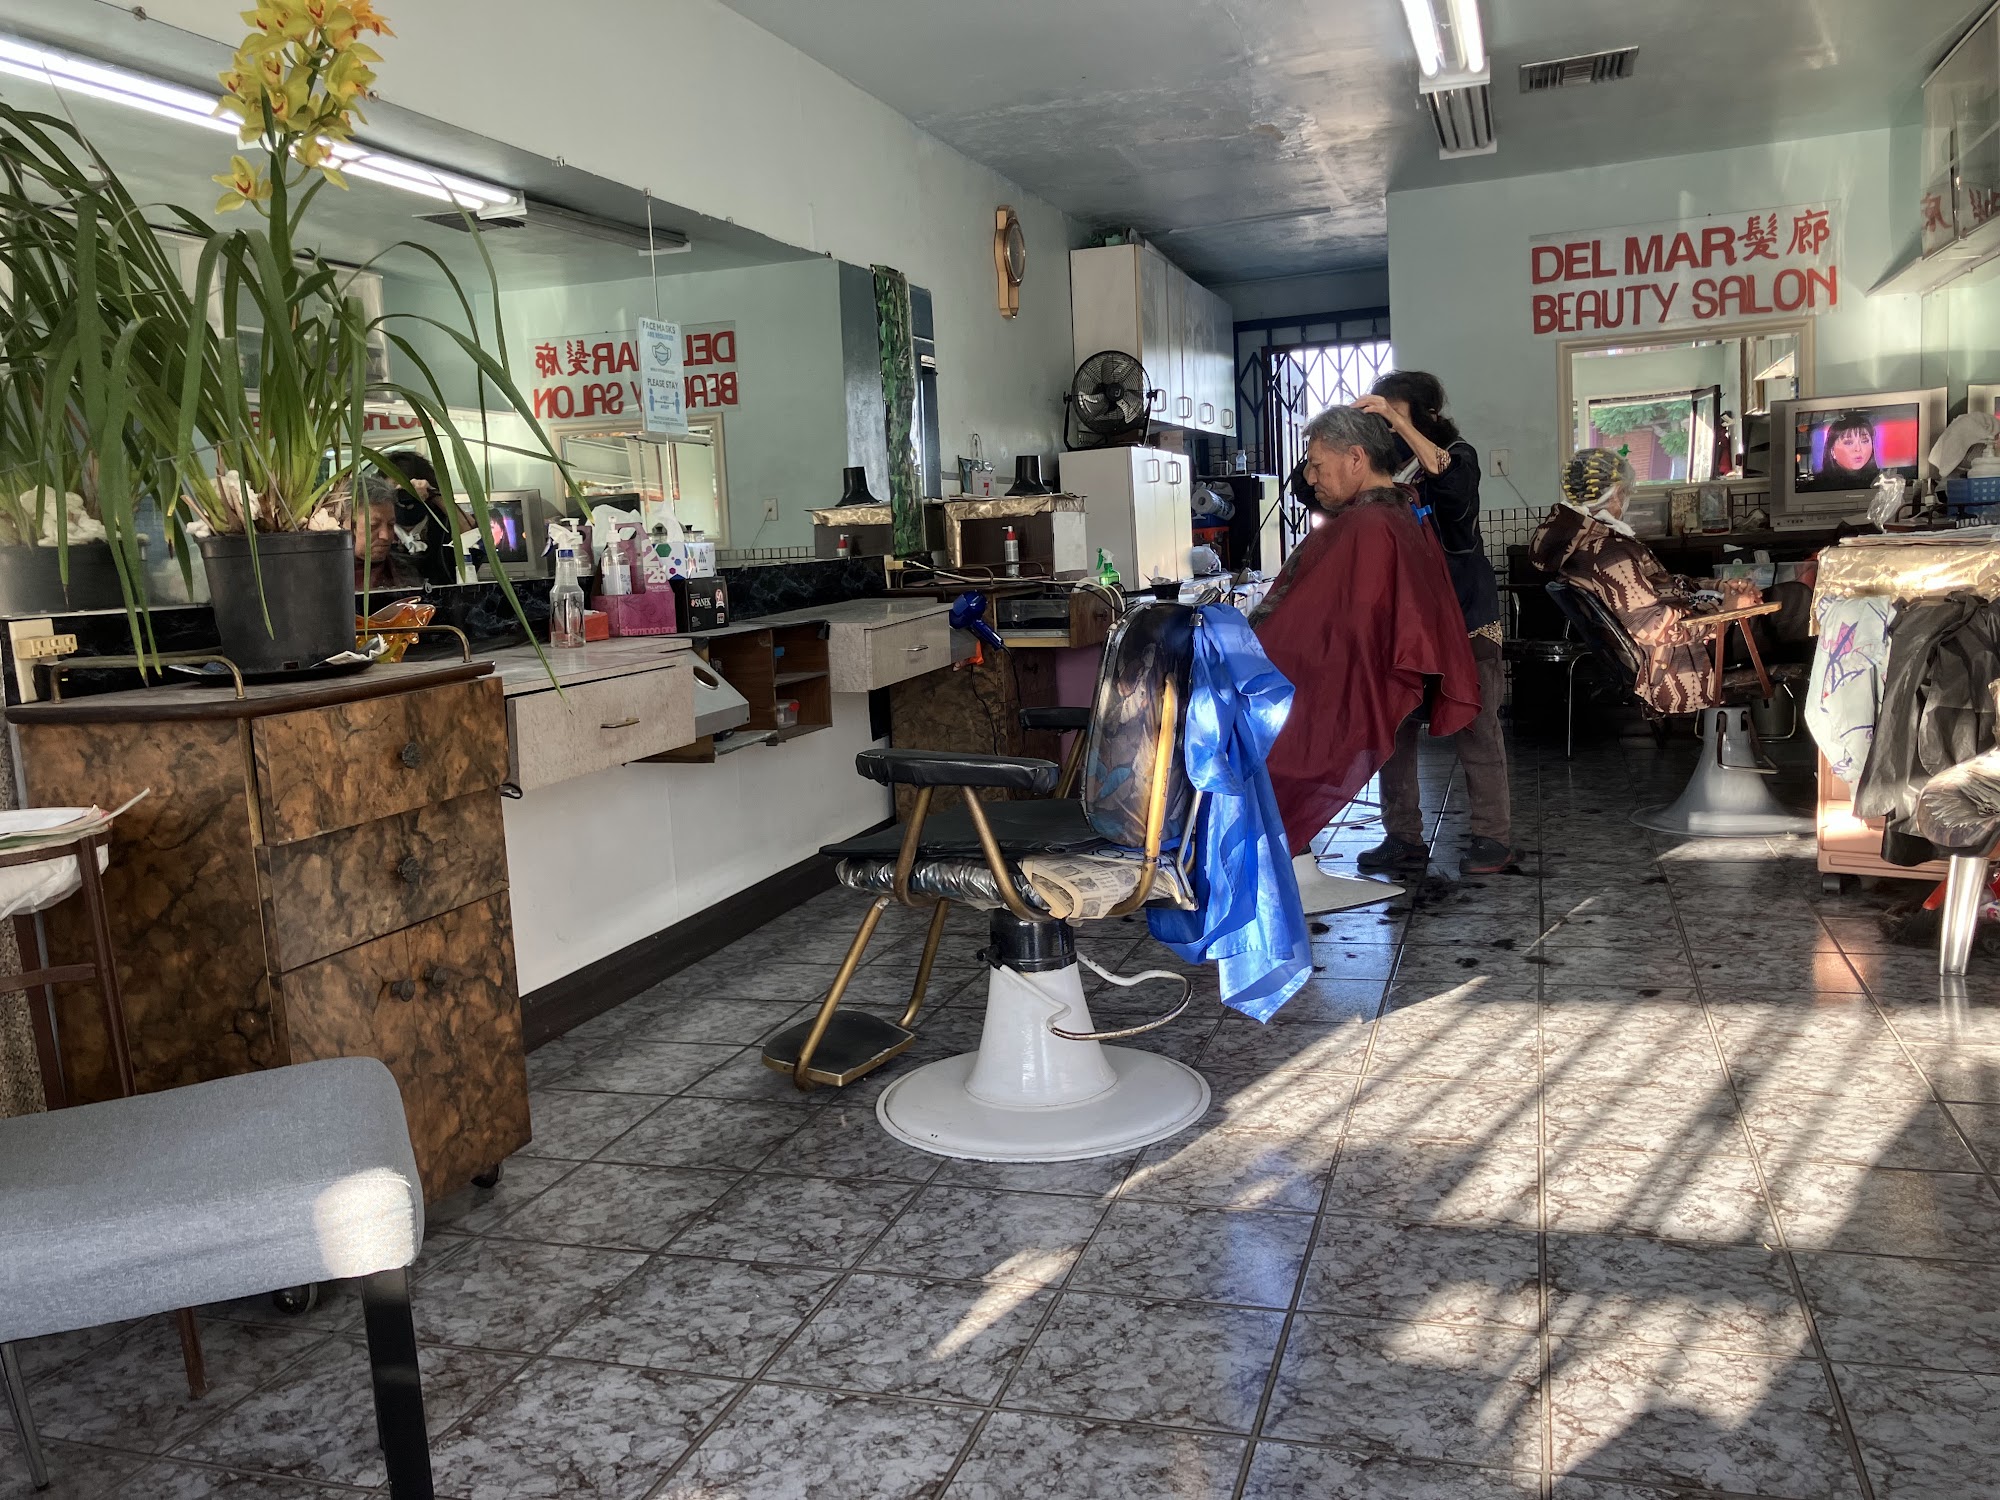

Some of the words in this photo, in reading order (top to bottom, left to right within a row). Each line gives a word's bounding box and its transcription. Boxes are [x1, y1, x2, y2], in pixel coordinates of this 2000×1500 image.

[1737, 209, 1830, 262] 髮廊
[1531, 240, 1617, 285] DEL
[1624, 226, 1737, 276] MAR
[1533, 282, 1679, 334] BEAUTY
[1691, 265, 1837, 320] SALON
[642, 320, 656, 331] FACE
[656, 323, 676, 335] MASKS
[647, 377, 665, 388] PLEASE
[666, 381, 679, 389] STAY
[621, 626, 661, 637] shampoo
